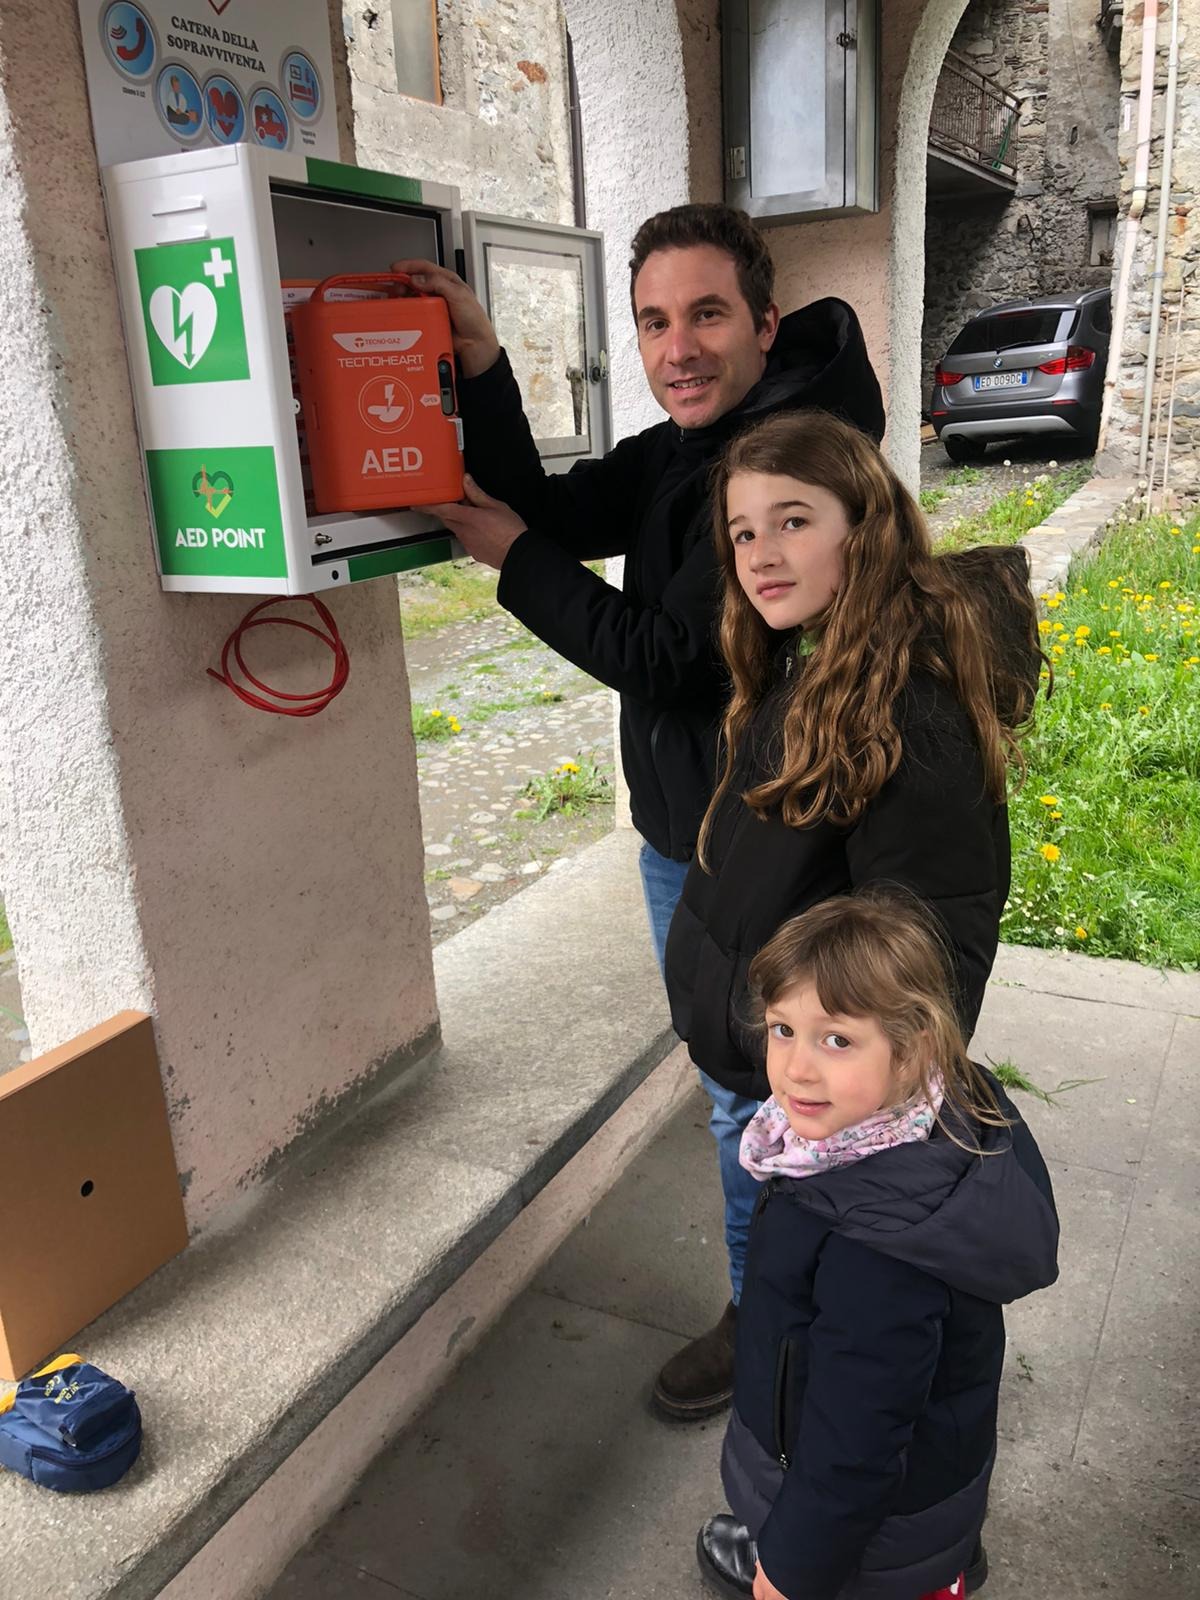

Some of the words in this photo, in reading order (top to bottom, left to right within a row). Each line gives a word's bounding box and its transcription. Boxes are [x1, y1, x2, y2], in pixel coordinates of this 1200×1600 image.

[171, 15, 220, 41] CATENA
[222, 30, 259, 52] DELLA
[167, 34, 266, 73] SOPRAVVIVENZA
[337, 354, 424, 369] TECNOHEART
[361, 446, 423, 474] AED
[175, 527, 208, 548] AED
[212, 527, 266, 548] POINT
